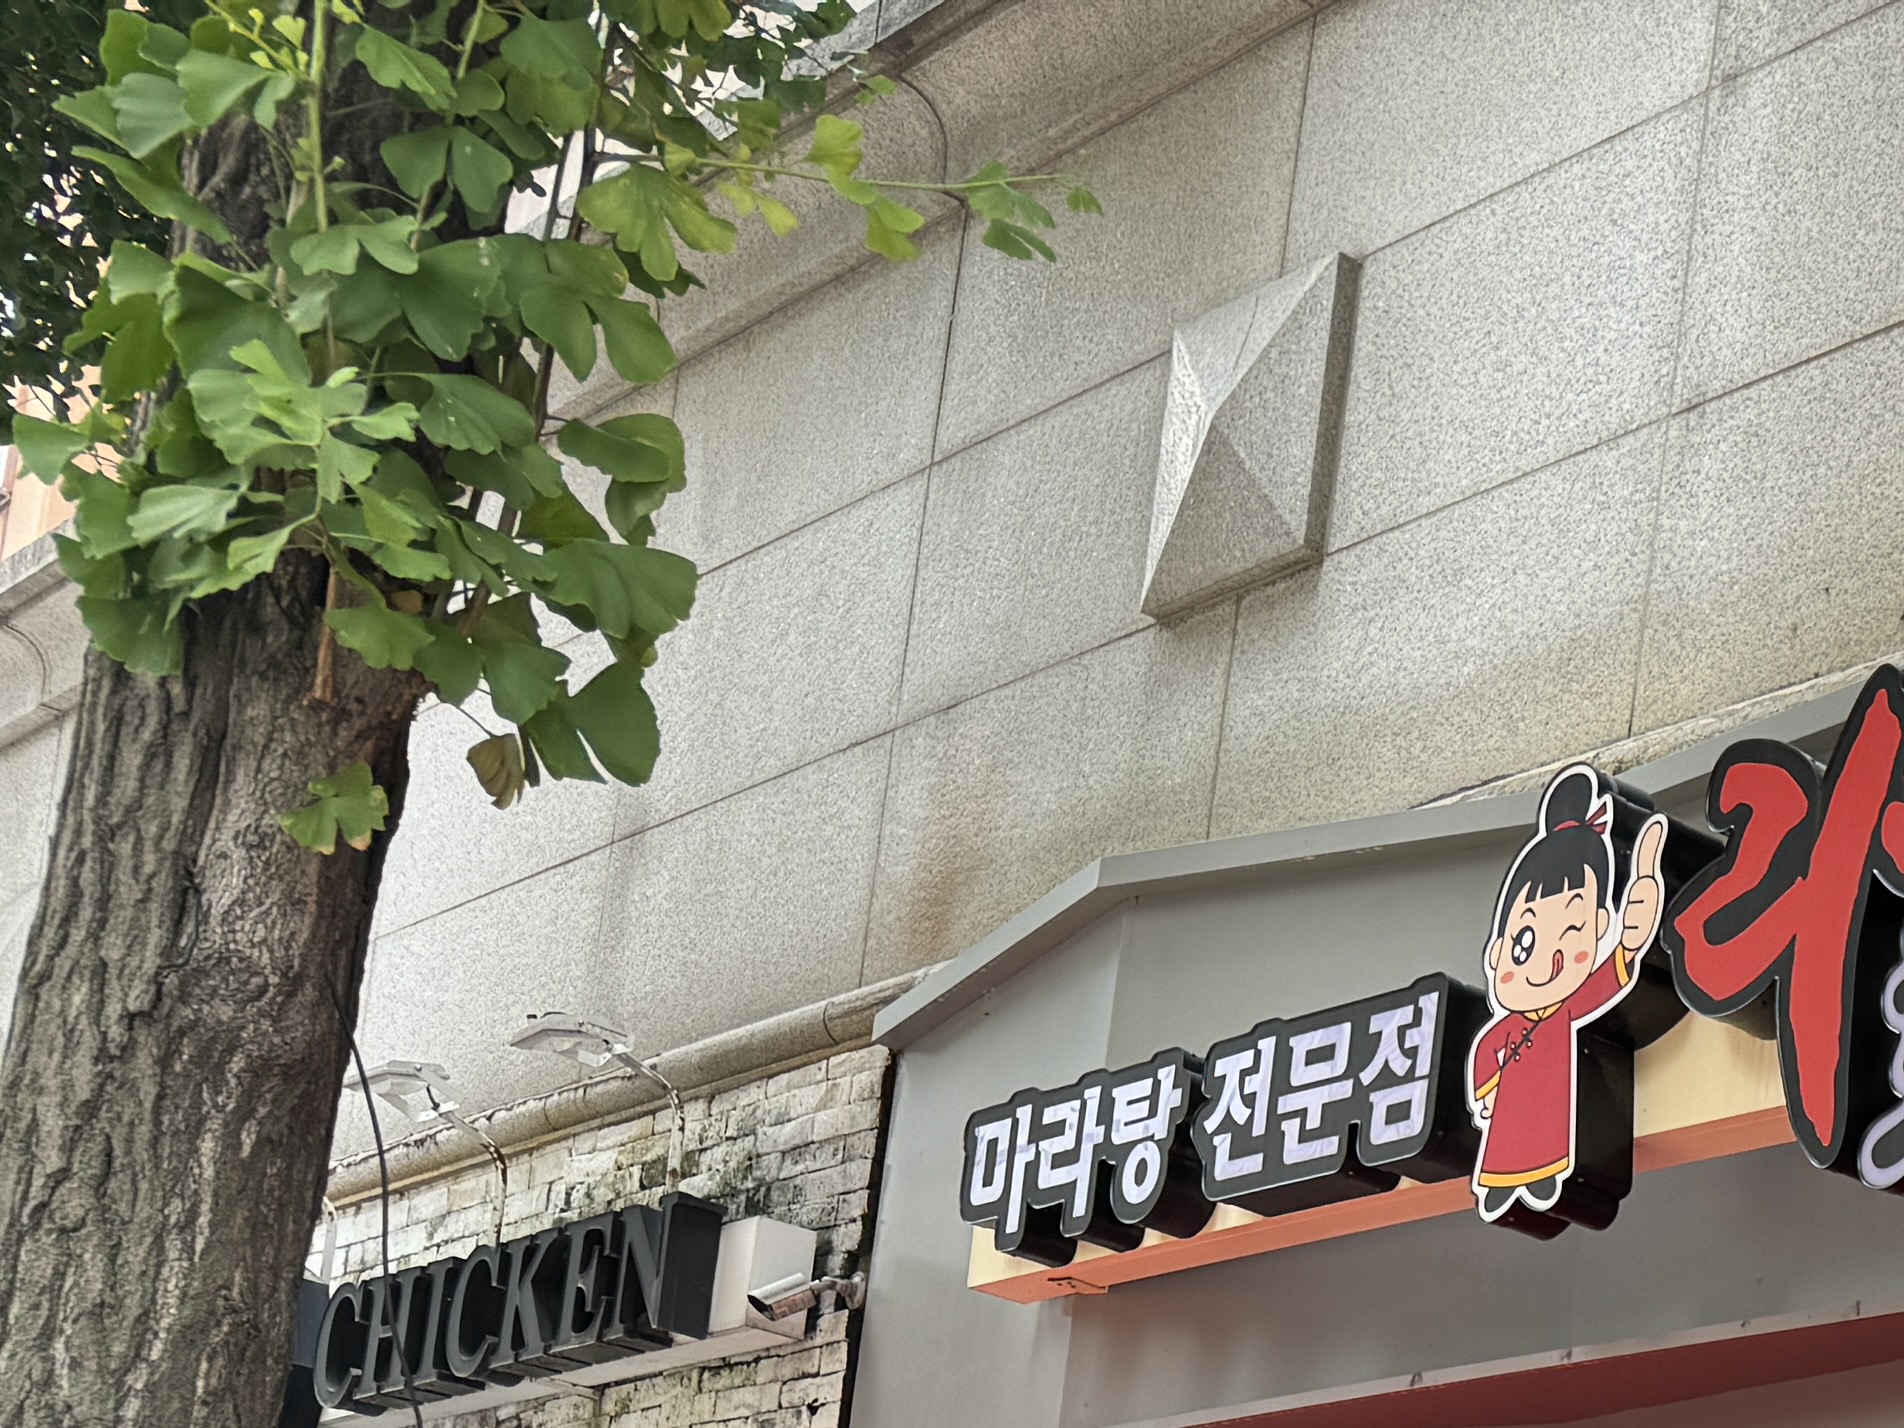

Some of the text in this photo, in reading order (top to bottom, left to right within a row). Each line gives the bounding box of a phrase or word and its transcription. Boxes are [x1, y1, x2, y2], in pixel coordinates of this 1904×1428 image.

[970, 995, 1440, 1233] 마라탕 전문점
[315, 1206, 664, 1410] CHICKEN
